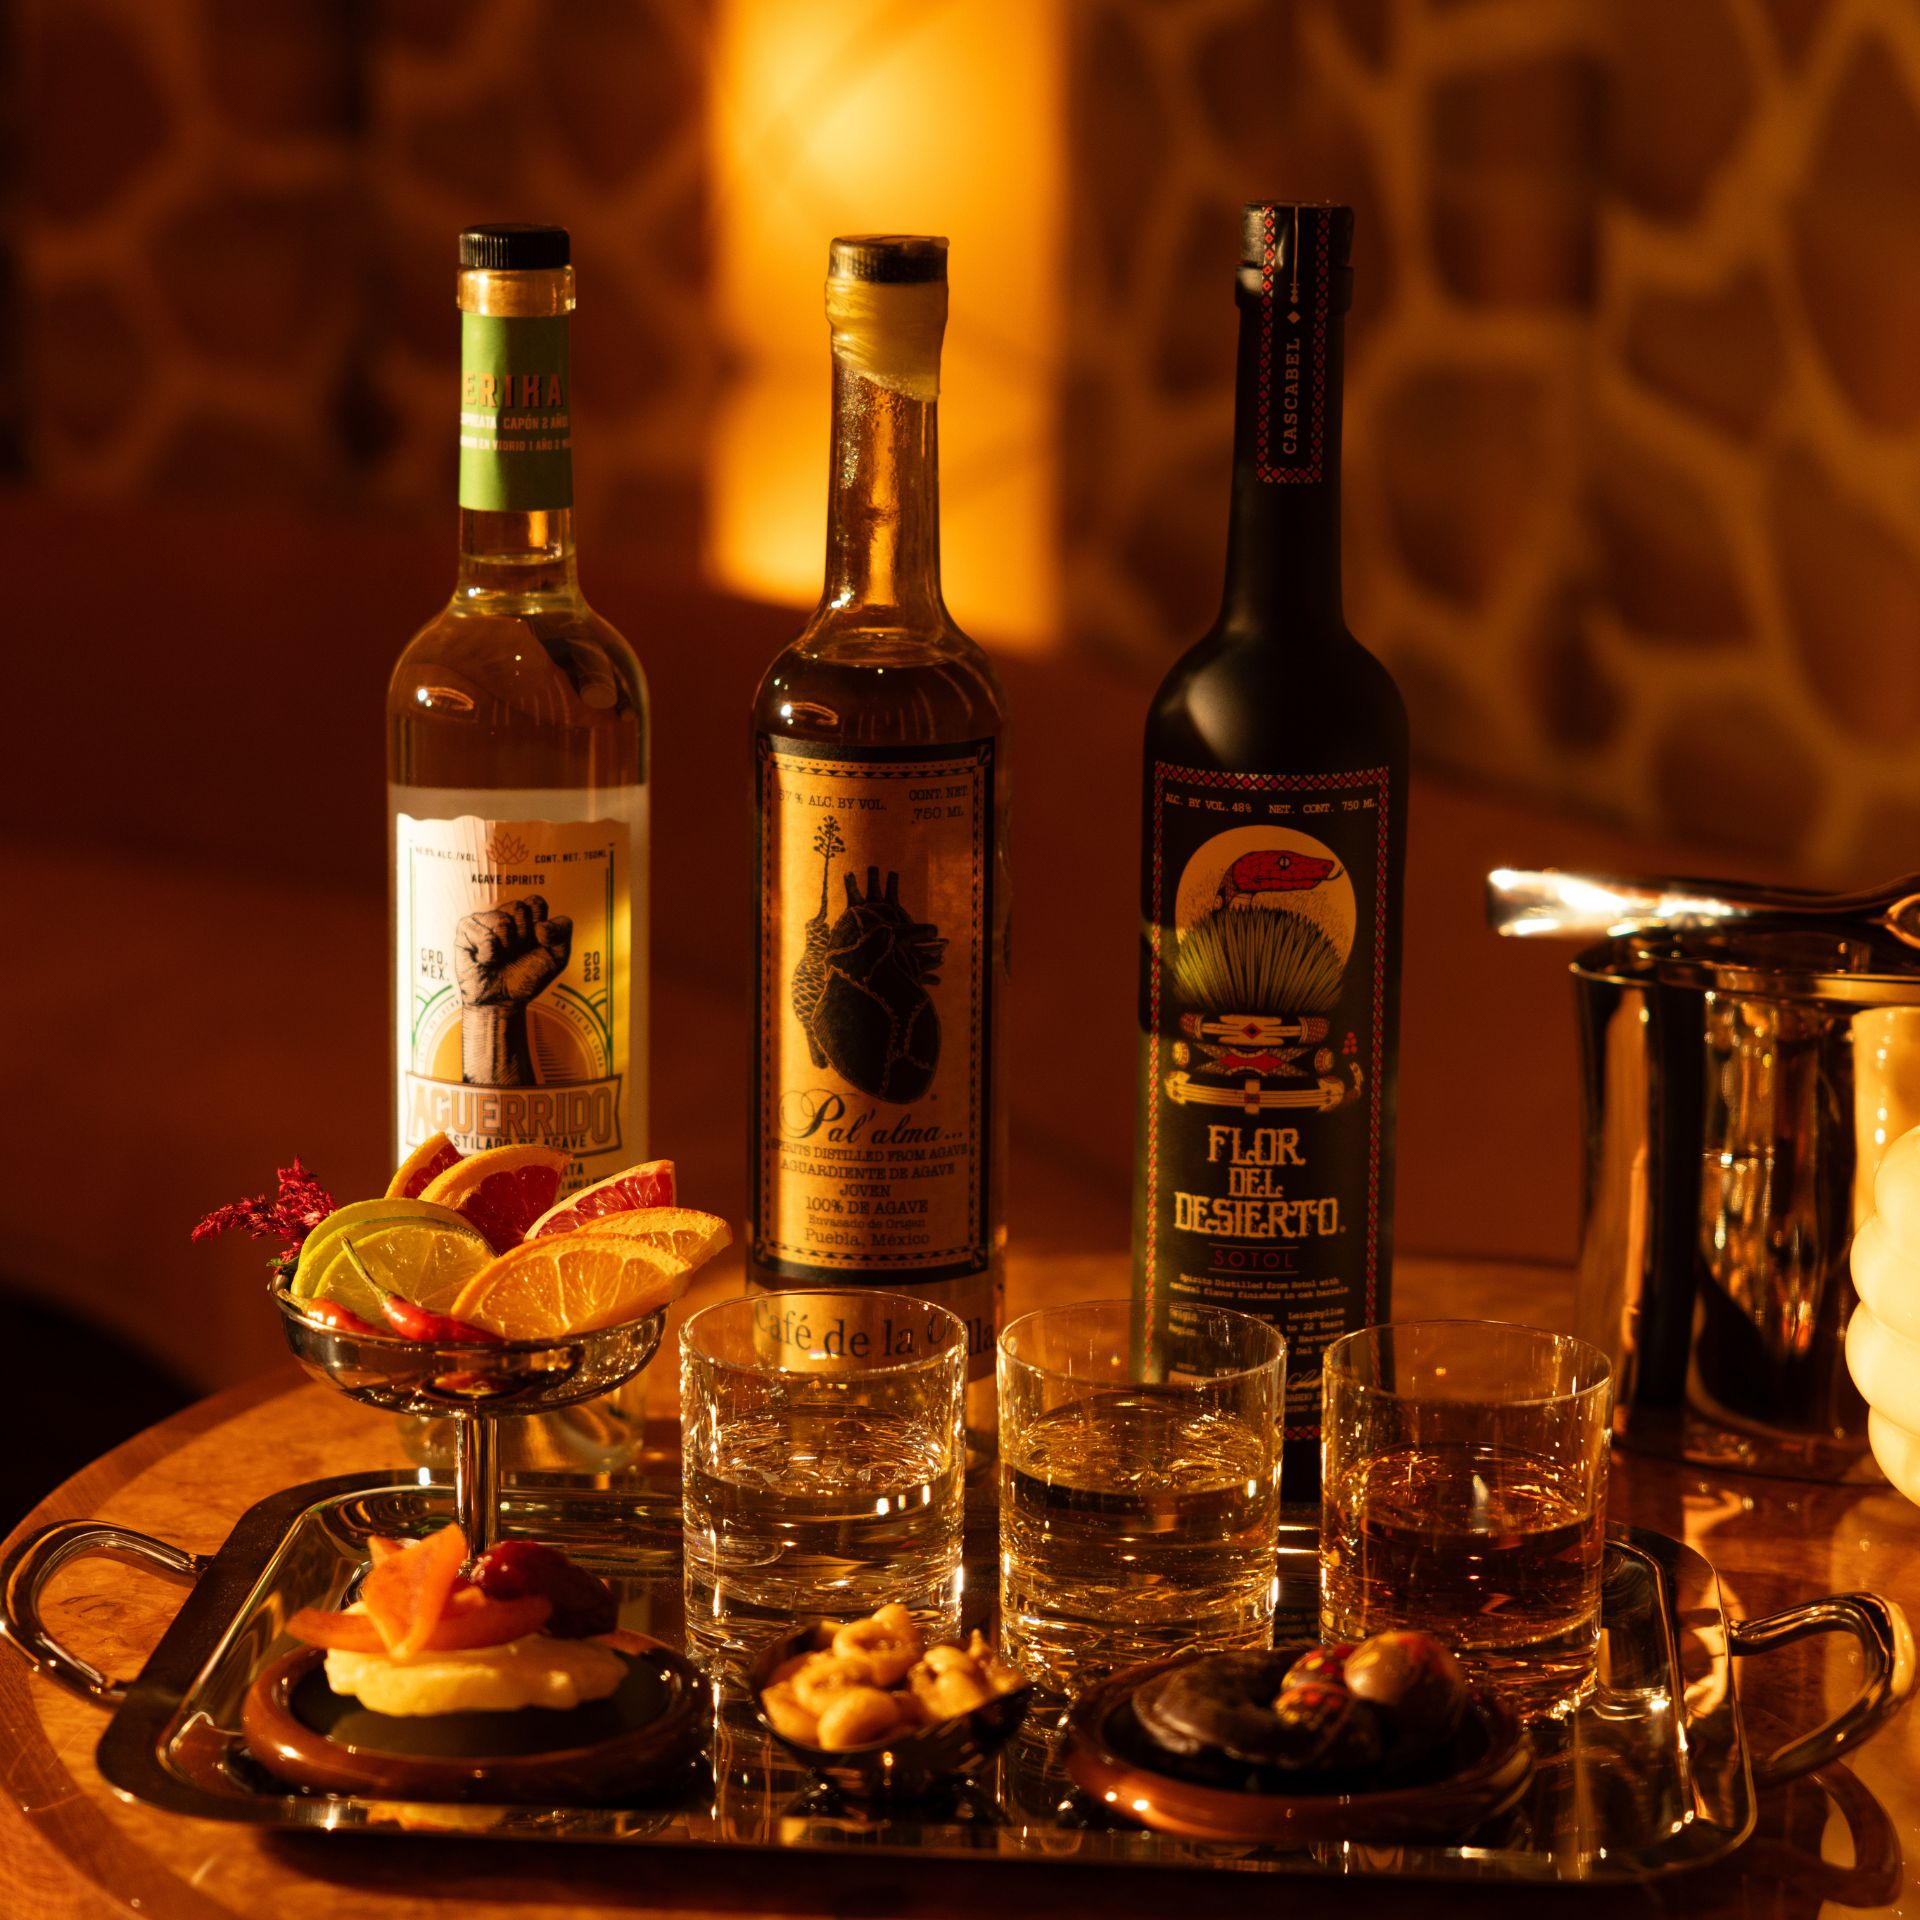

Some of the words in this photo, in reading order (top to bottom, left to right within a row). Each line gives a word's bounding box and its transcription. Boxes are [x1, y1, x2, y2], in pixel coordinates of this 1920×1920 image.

[1282, 338, 1300, 455] CASCABEL
[808, 794, 835, 809] ALC.
[838, 797, 856, 810] BY
[857, 798, 887, 811] VOL.
[1188, 797, 1200, 809] BY
[1205, 800, 1229, 811] VOL.
[1231, 803, 1253, 813] 48%
[1268, 804, 1296, 815] NET.
[1303, 803, 1335, 814] CONT.
[1342, 800, 1359, 811] 750
[913, 806, 942, 820] 750
[471, 874, 502, 885] AGAVE
[505, 874, 545, 886] SPIRITS
[583, 951, 601, 967] 20
[583, 967, 601, 983] 22
[413, 1086, 612, 1145] AGUERRIDO
[448, 1134, 511, 1150] ESTILADO
[1206, 1125, 1306, 1166] FLOR
[813, 1147, 884, 1162] DISTILLED
[888, 1150, 926, 1162] FROM
[929, 1143, 968, 1160] AGAVE
[781, 1158, 886, 1180] AGUARDIENTE
[889, 1168, 909, 1180] DE
[911, 1163, 955, 1179] AGAVE
[839, 1184, 891, 1197] JOVEN
[1227, 1167, 1284, 1198] DEL
[805, 1196, 844, 1214] 100%
[847, 1201, 870, 1215] DE
[874, 1199, 929, 1215] AGAVE
[808, 1214, 865, 1228] Envasado
[868, 1219, 881, 1229] de
[885, 1219, 926, 1231] Origen
[804, 1227, 866, 1248] Puebla,
[871, 1231, 930, 1246] México
[1214, 1250, 1293, 1268] SOTOL
[1179, 1272, 1213, 1287] Spirits
[1215, 1279, 1264, 1290] Distilled
[1266, 1280, 1290, 1290] from
[1291, 1278, 1317, 1289] Sotol
[1319, 1277, 1340, 1287] with
[1203, 1287, 1234, 1298] flavor
[1237, 1289, 1282, 1300] finished
[1283, 1290, 1296, 1300] in
[1297, 1289, 1314, 1299] oak
[1316, 1286, 1351, 1298] barrels
[754, 1300, 812, 1351] Café
[824, 1318, 870, 1359] de
[882, 1319, 915, 1357] la
